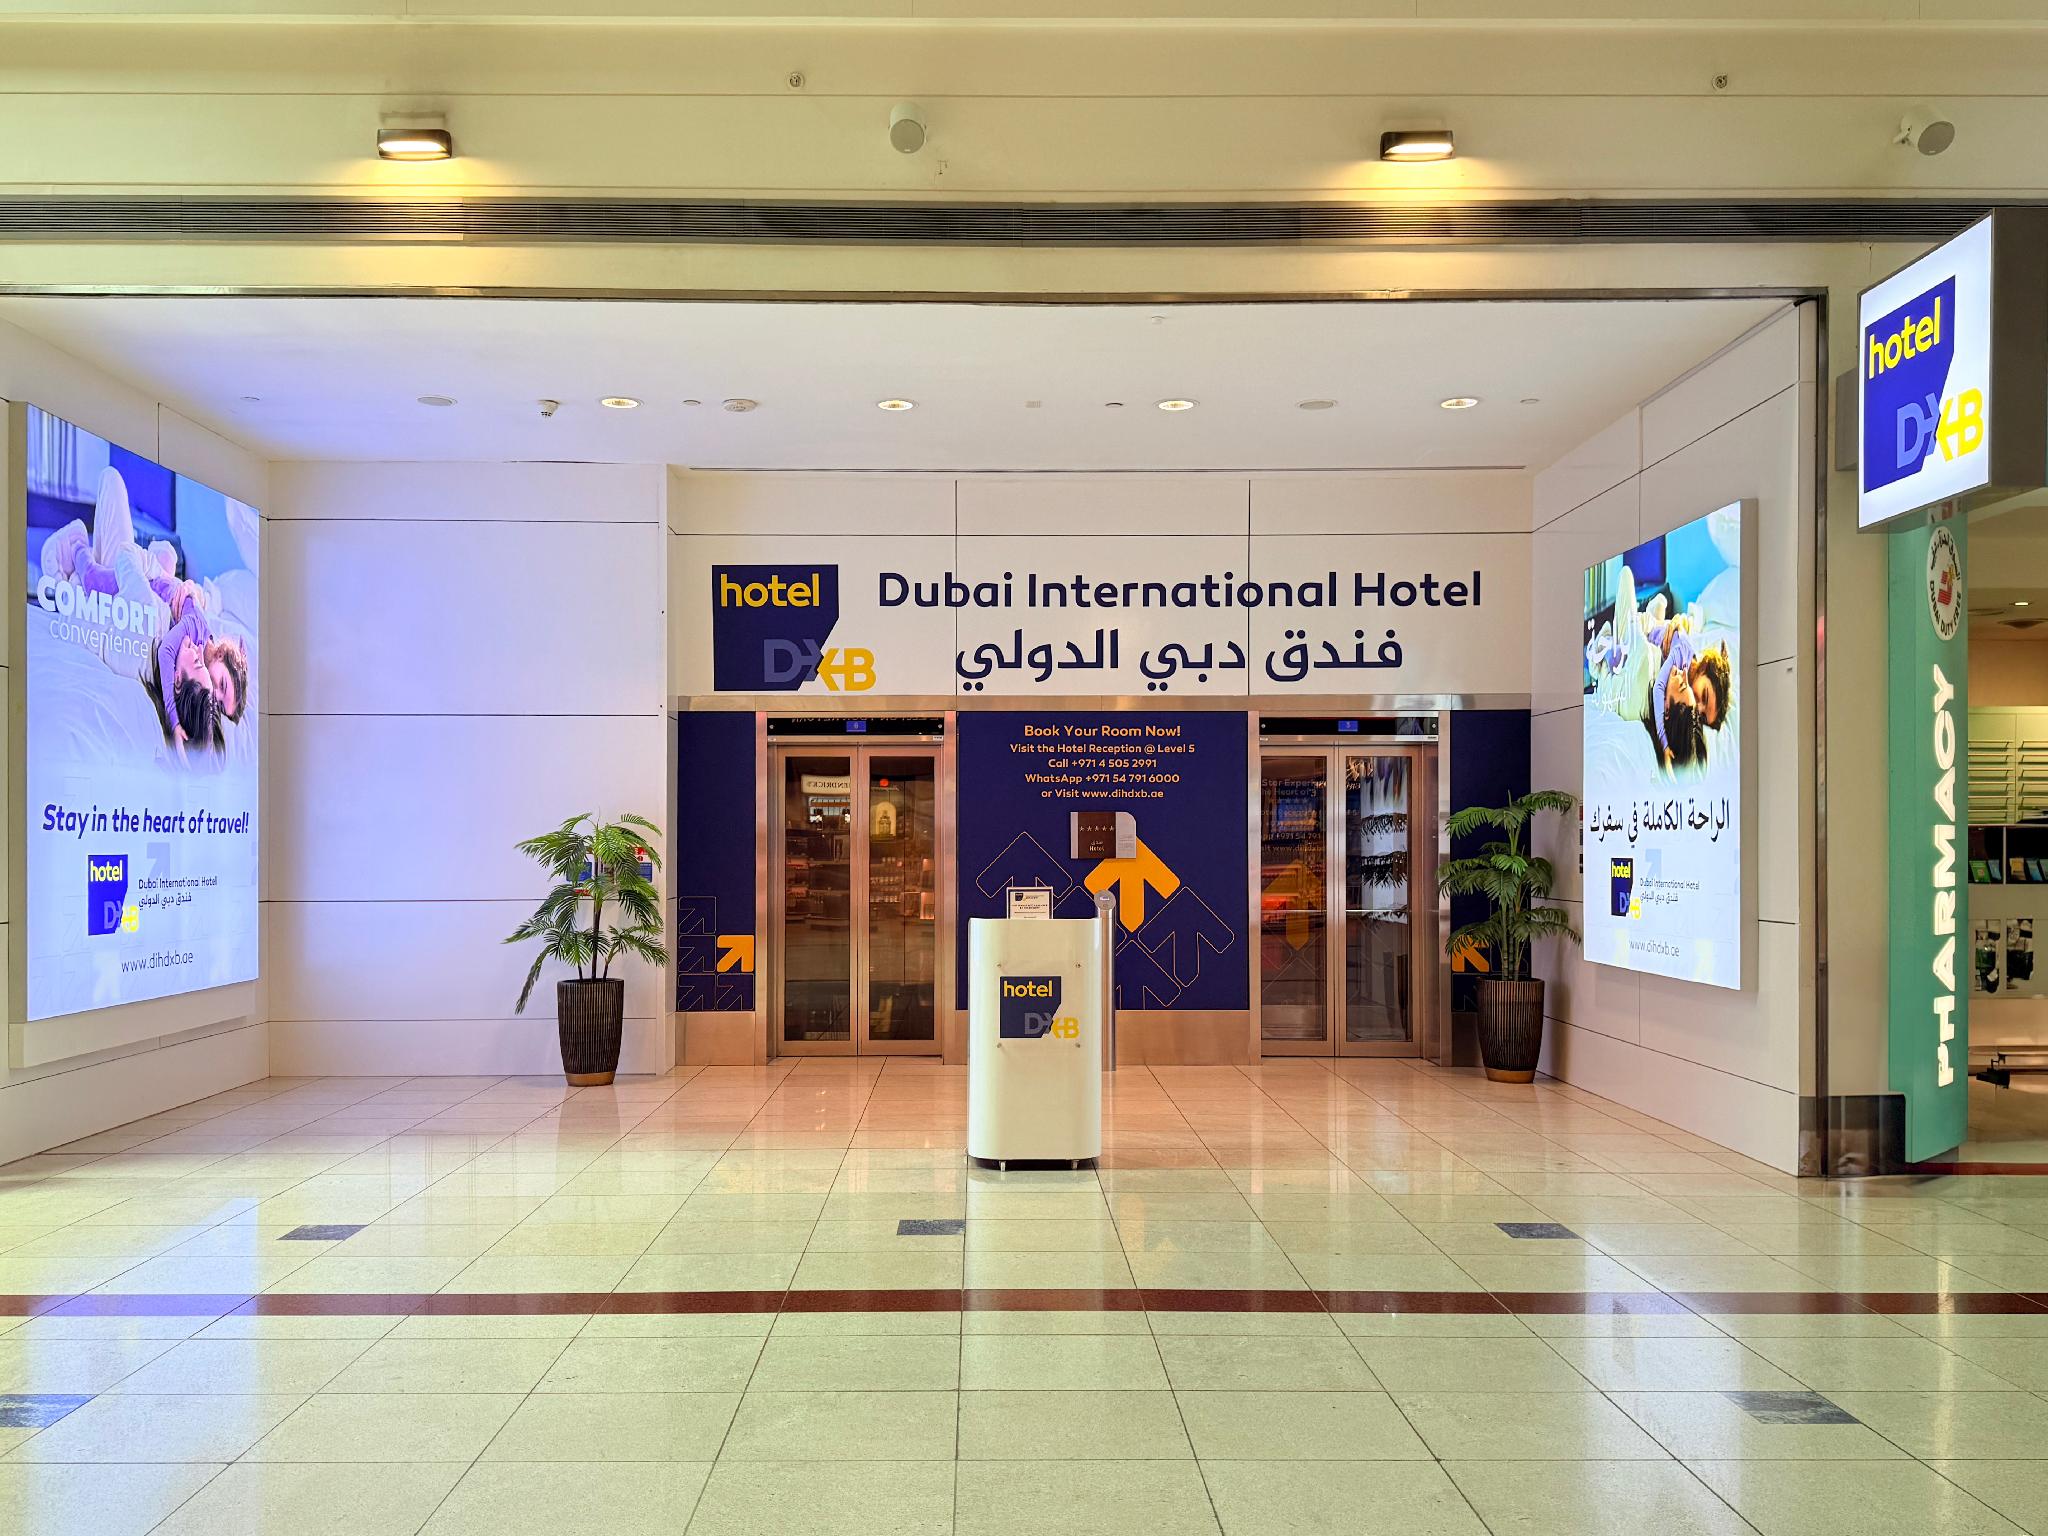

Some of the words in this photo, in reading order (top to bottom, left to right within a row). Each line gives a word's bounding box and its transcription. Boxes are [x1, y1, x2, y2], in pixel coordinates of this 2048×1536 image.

[1868, 296, 1941, 379] hotel
[1896, 388, 1984, 470] DXB
[720, 573, 820, 607] hotel
[880, 571, 1013, 607] Dubai
[1028, 571, 1337, 607] International
[1354, 571, 1481, 606] Hotel
[37, 576, 158, 637] COMFORT
[50, 618, 148, 658] convenience
[763, 638, 876, 691] DXB
[955, 628, 1119, 691] الدولي
[1139, 640, 1246, 691] دبي
[1265, 629, 1403, 682] فندق
[1024, 725, 1059, 737] Book
[1064, 725, 1098, 737] Your
[1101, 725, 1141, 737] Room
[1145, 725, 1181, 737] Now!
[1010, 743, 1035, 753] Visit
[1037, 743, 1055, 753] the
[1057, 743, 1087, 753] Hotel
[1089, 743, 1142, 754] Reception
[1144, 744, 1155, 754] @
[1158, 743, 1186, 753] Level
[1188, 744, 1195, 753] 5
[1048, 758, 1069, 768] Call
[1071, 759, 1097, 768] +971
[1099, 759, 1106, 768] 4
[1108, 759, 1130, 768] 505
[1132, 759, 1157, 768] 2991
[1025, 773, 1083, 784] WhatsApp
[1085, 774, 1111, 783] +971
[1112, 774, 1127, 783] 54
[1041, 790, 1052, 798] or
[1055, 788, 1080, 798] Visit
[1081, 788, 1164, 798] www.dihdxb.ae
[43, 804, 89, 839] Stay
[91, 805, 107, 832] in
[112, 806, 139, 833] the
[142, 809, 185, 834] heart
[188, 809, 206, 834] of
[207, 811, 249, 834] travel!
[1590, 804, 1624, 842] سفرك
[1627, 801, 1639, 848] في
[1643, 799, 1683, 832] الكاملة
[1688, 797, 1730, 843] الراحة
[90, 859, 123, 881] hotel
[138, 877, 159, 889] Dubai
[160, 876, 200, 888] International
[202, 876, 217, 886] Hotel
[1611, 861, 1631, 879] hotel
[1932, 663, 1957, 1088] PHARMACY
[138, 893, 160, 910] الدولي
[161, 895, 175, 909] دبي
[175, 892, 192, 905] فندق
[121, 950, 194, 973] www.dihdxb.ae
[1003, 980, 1053, 998] hotel
[1024, 1012, 1080, 1039] DXB
